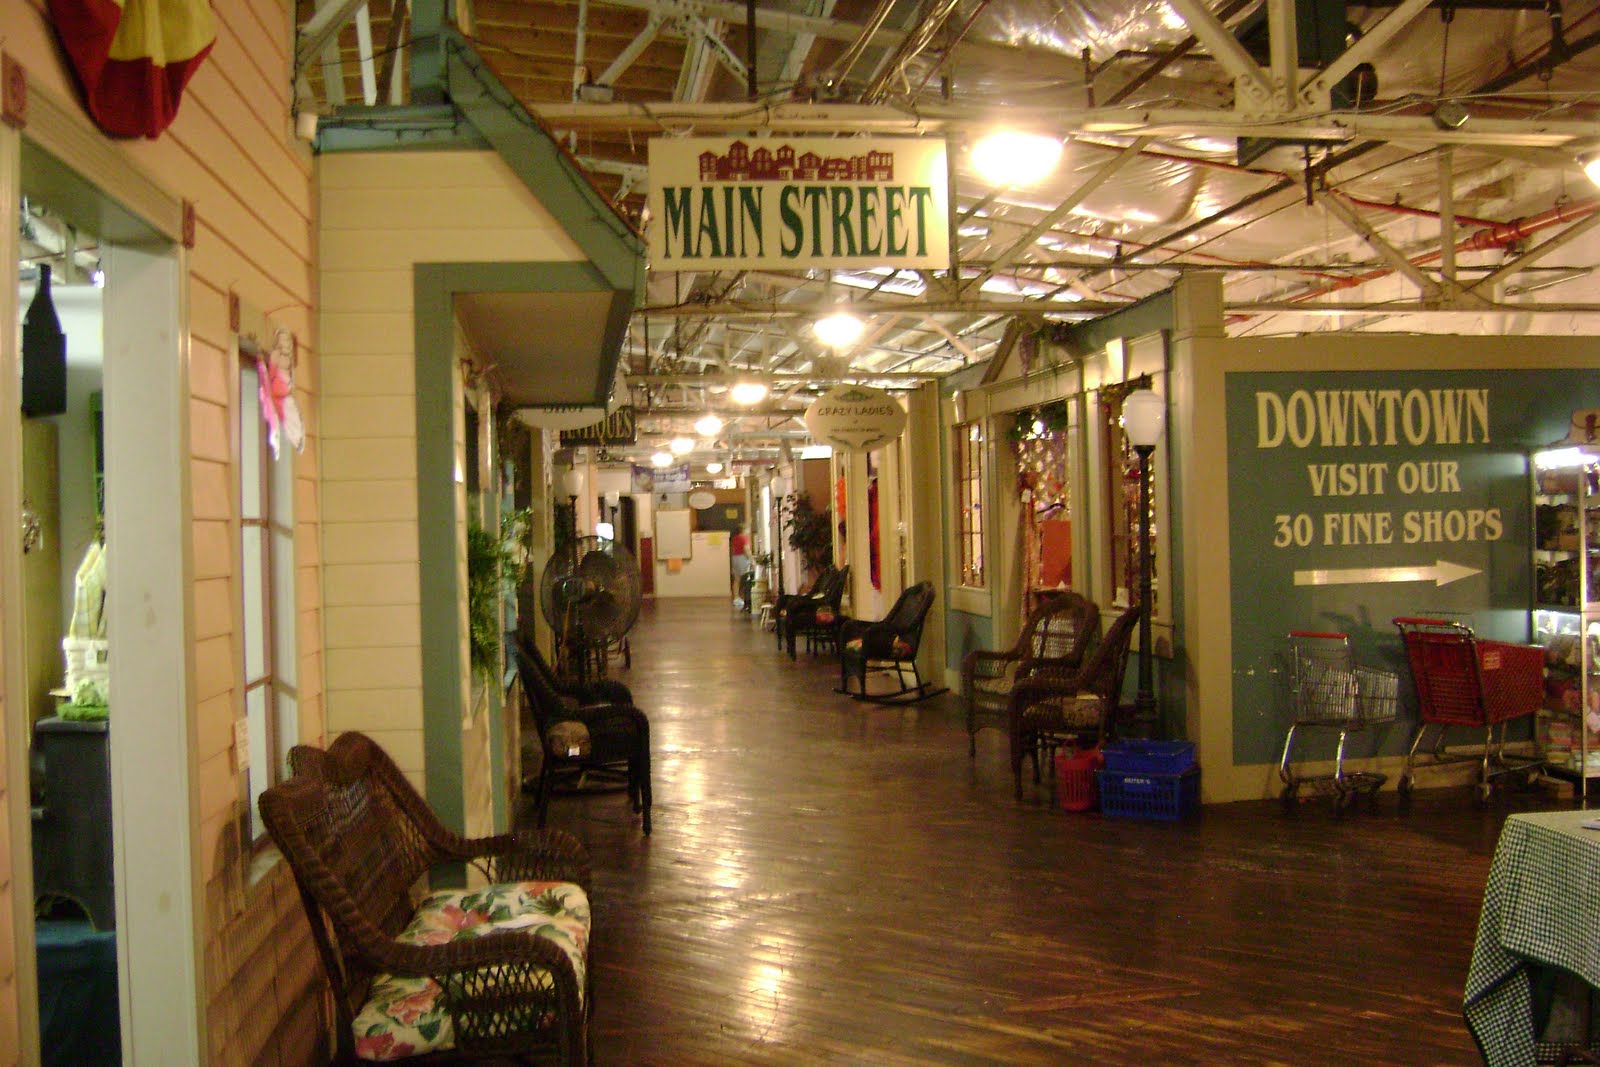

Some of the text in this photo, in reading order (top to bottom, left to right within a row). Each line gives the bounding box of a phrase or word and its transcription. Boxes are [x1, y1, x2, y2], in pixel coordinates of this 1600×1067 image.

[662, 185, 933, 258] MAIN STREET
[562, 408, 633, 442] IQUES
[817, 405, 894, 416] CRAZY LADIES
[1256, 388, 1491, 448] DOWNTOWN
[1307, 461, 1462, 496] VISIT OUR
[1273, 508, 1504, 548] 30 FINE SHOPS
